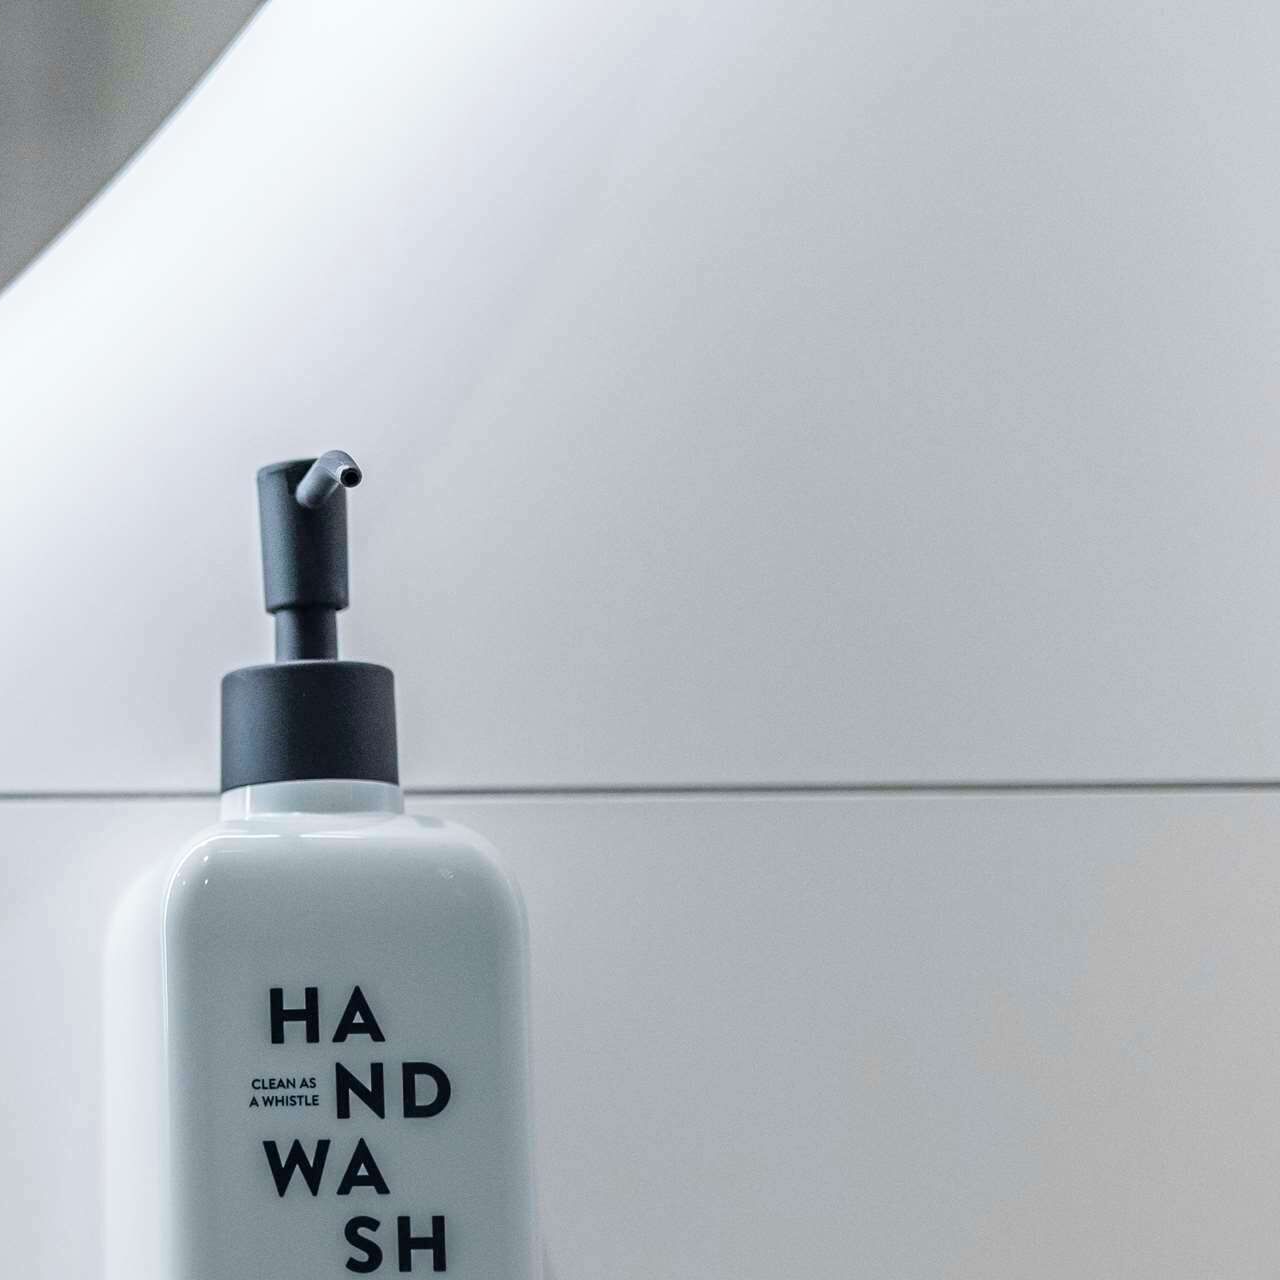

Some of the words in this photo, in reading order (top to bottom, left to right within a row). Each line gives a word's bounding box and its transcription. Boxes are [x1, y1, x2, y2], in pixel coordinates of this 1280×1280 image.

[269, 985, 386, 1045] HA
[248, 1096, 260, 1108] A
[261, 1095, 320, 1107] WHISTLE
[251, 1077, 297, 1090] CLEAN
[299, 1077, 317, 1089] AS
[335, 1062, 452, 1119] ND
[262, 1137, 391, 1198] WA
[344, 1215, 447, 1274] SH
